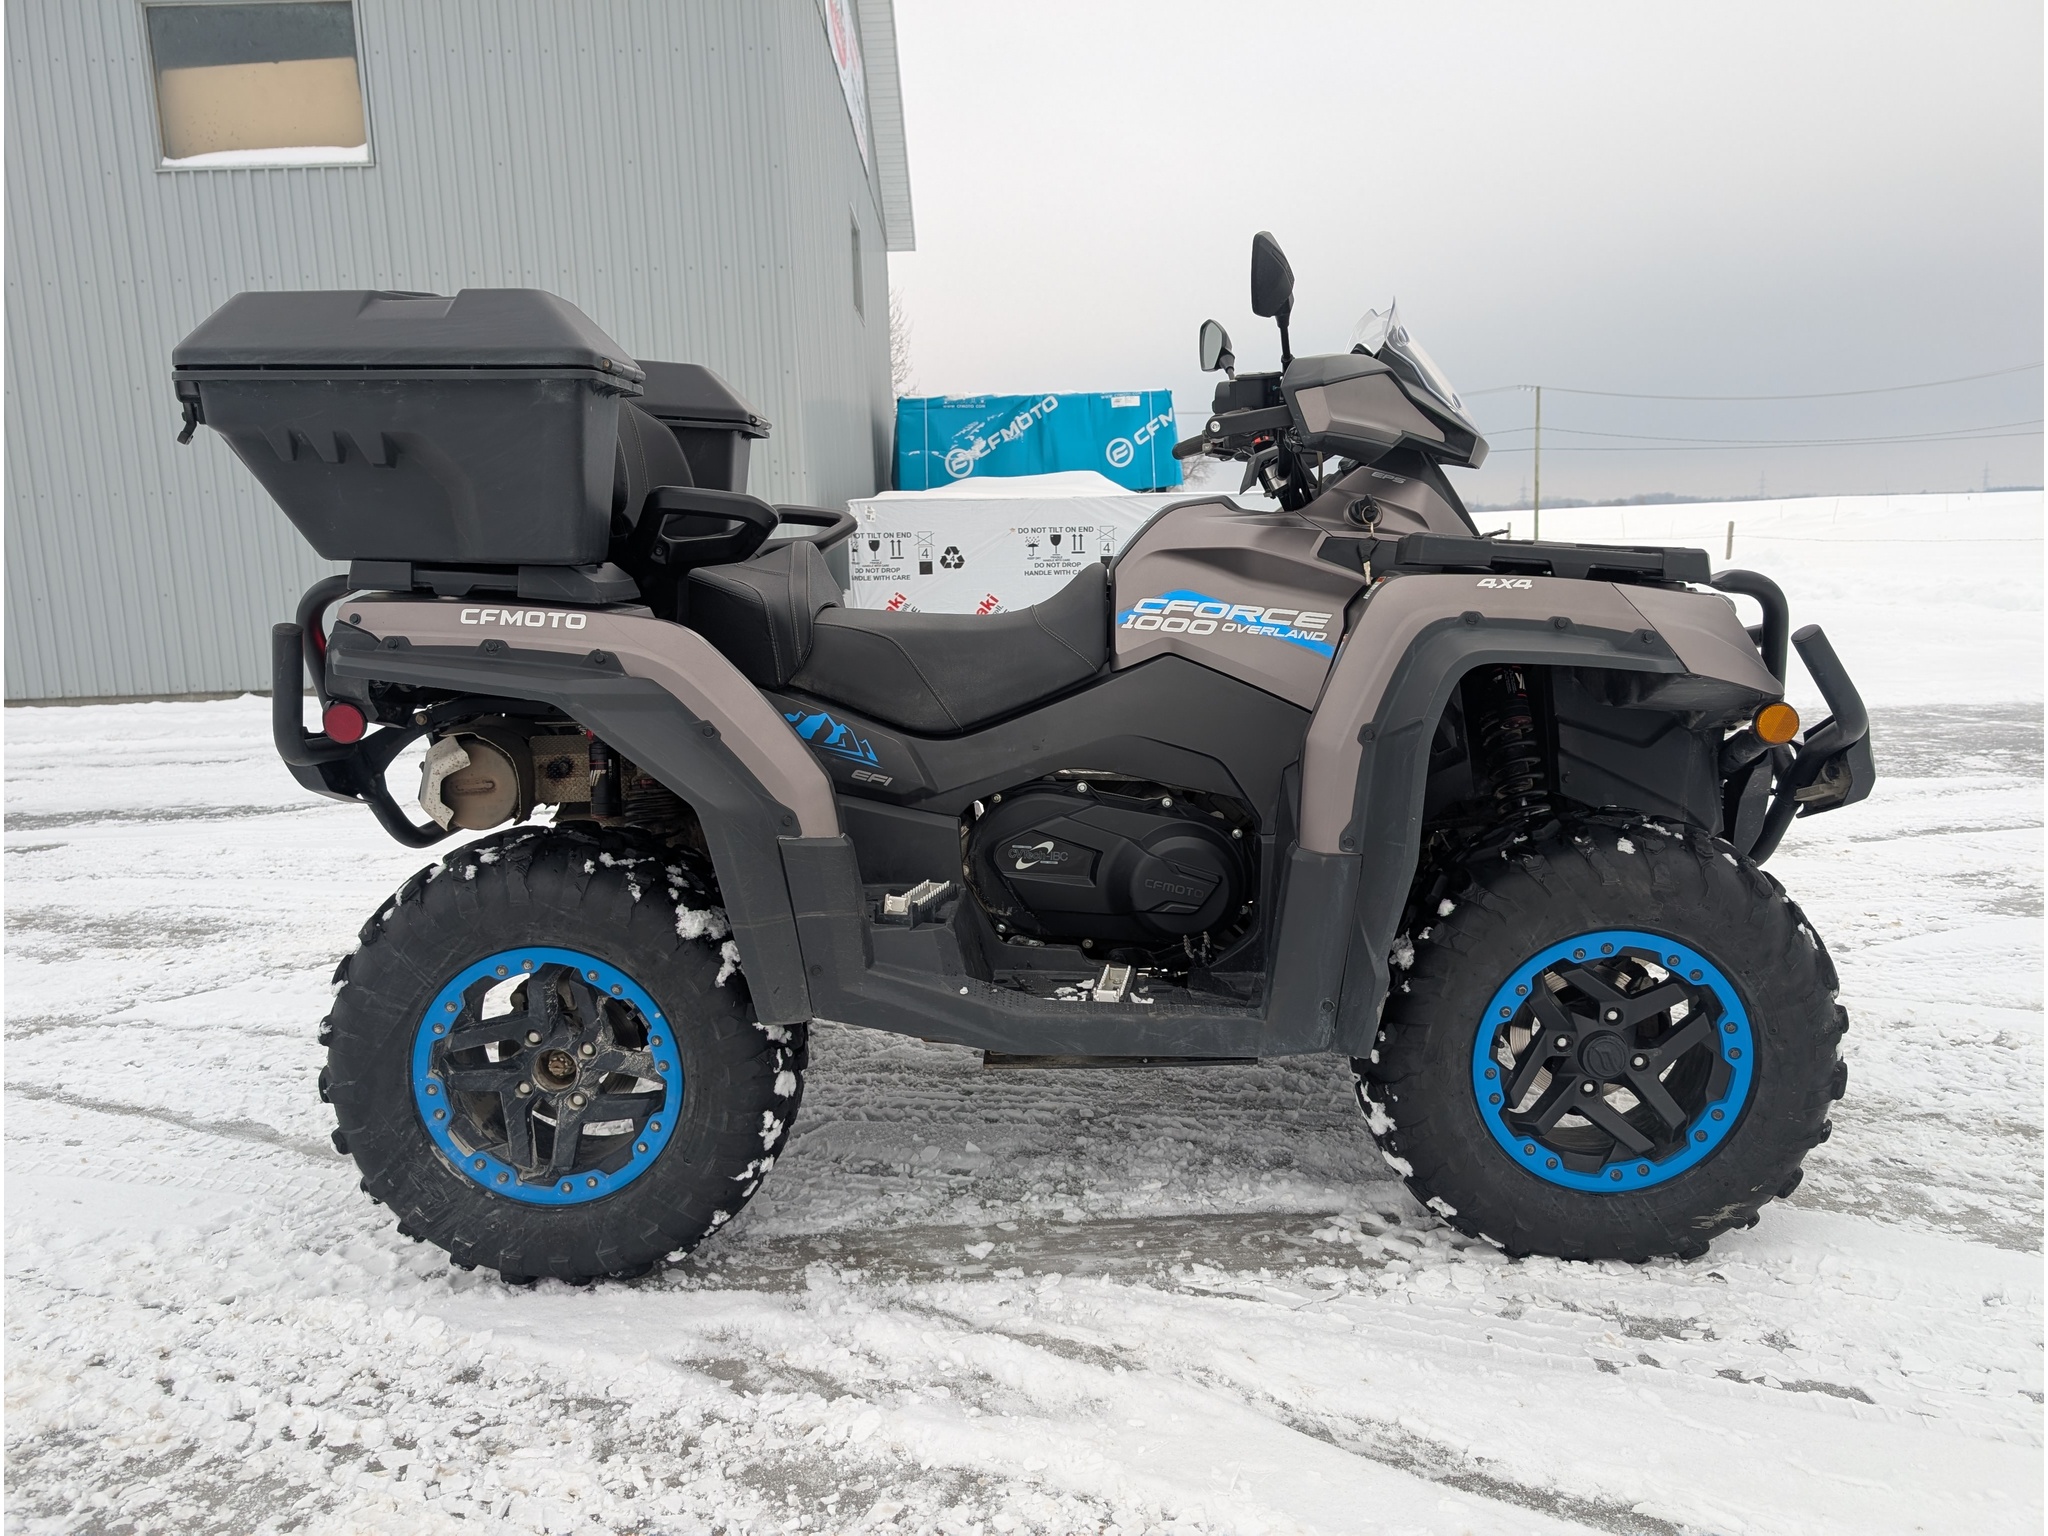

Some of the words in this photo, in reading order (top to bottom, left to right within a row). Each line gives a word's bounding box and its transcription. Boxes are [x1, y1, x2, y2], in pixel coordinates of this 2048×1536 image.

[976, 395, 1059, 459] CFMOTO
[1371, 471, 1407, 484] EPS
[896, 531, 912, 539] END
[921, 548, 930, 559] 4
[1102, 542, 1111, 554] 4
[1024, 569, 1053, 577] HANDLE
[1476, 578, 1533, 590] 4X4
[460, 608, 587, 630] CFMOTO
[1133, 598, 1333, 630] CFORCE
[1121, 614, 1218, 636] 1000
[1221, 622, 1328, 642] OVERLAND
[850, 769, 894, 787] EFI
[1145, 879, 1204, 898] CFMOTO
